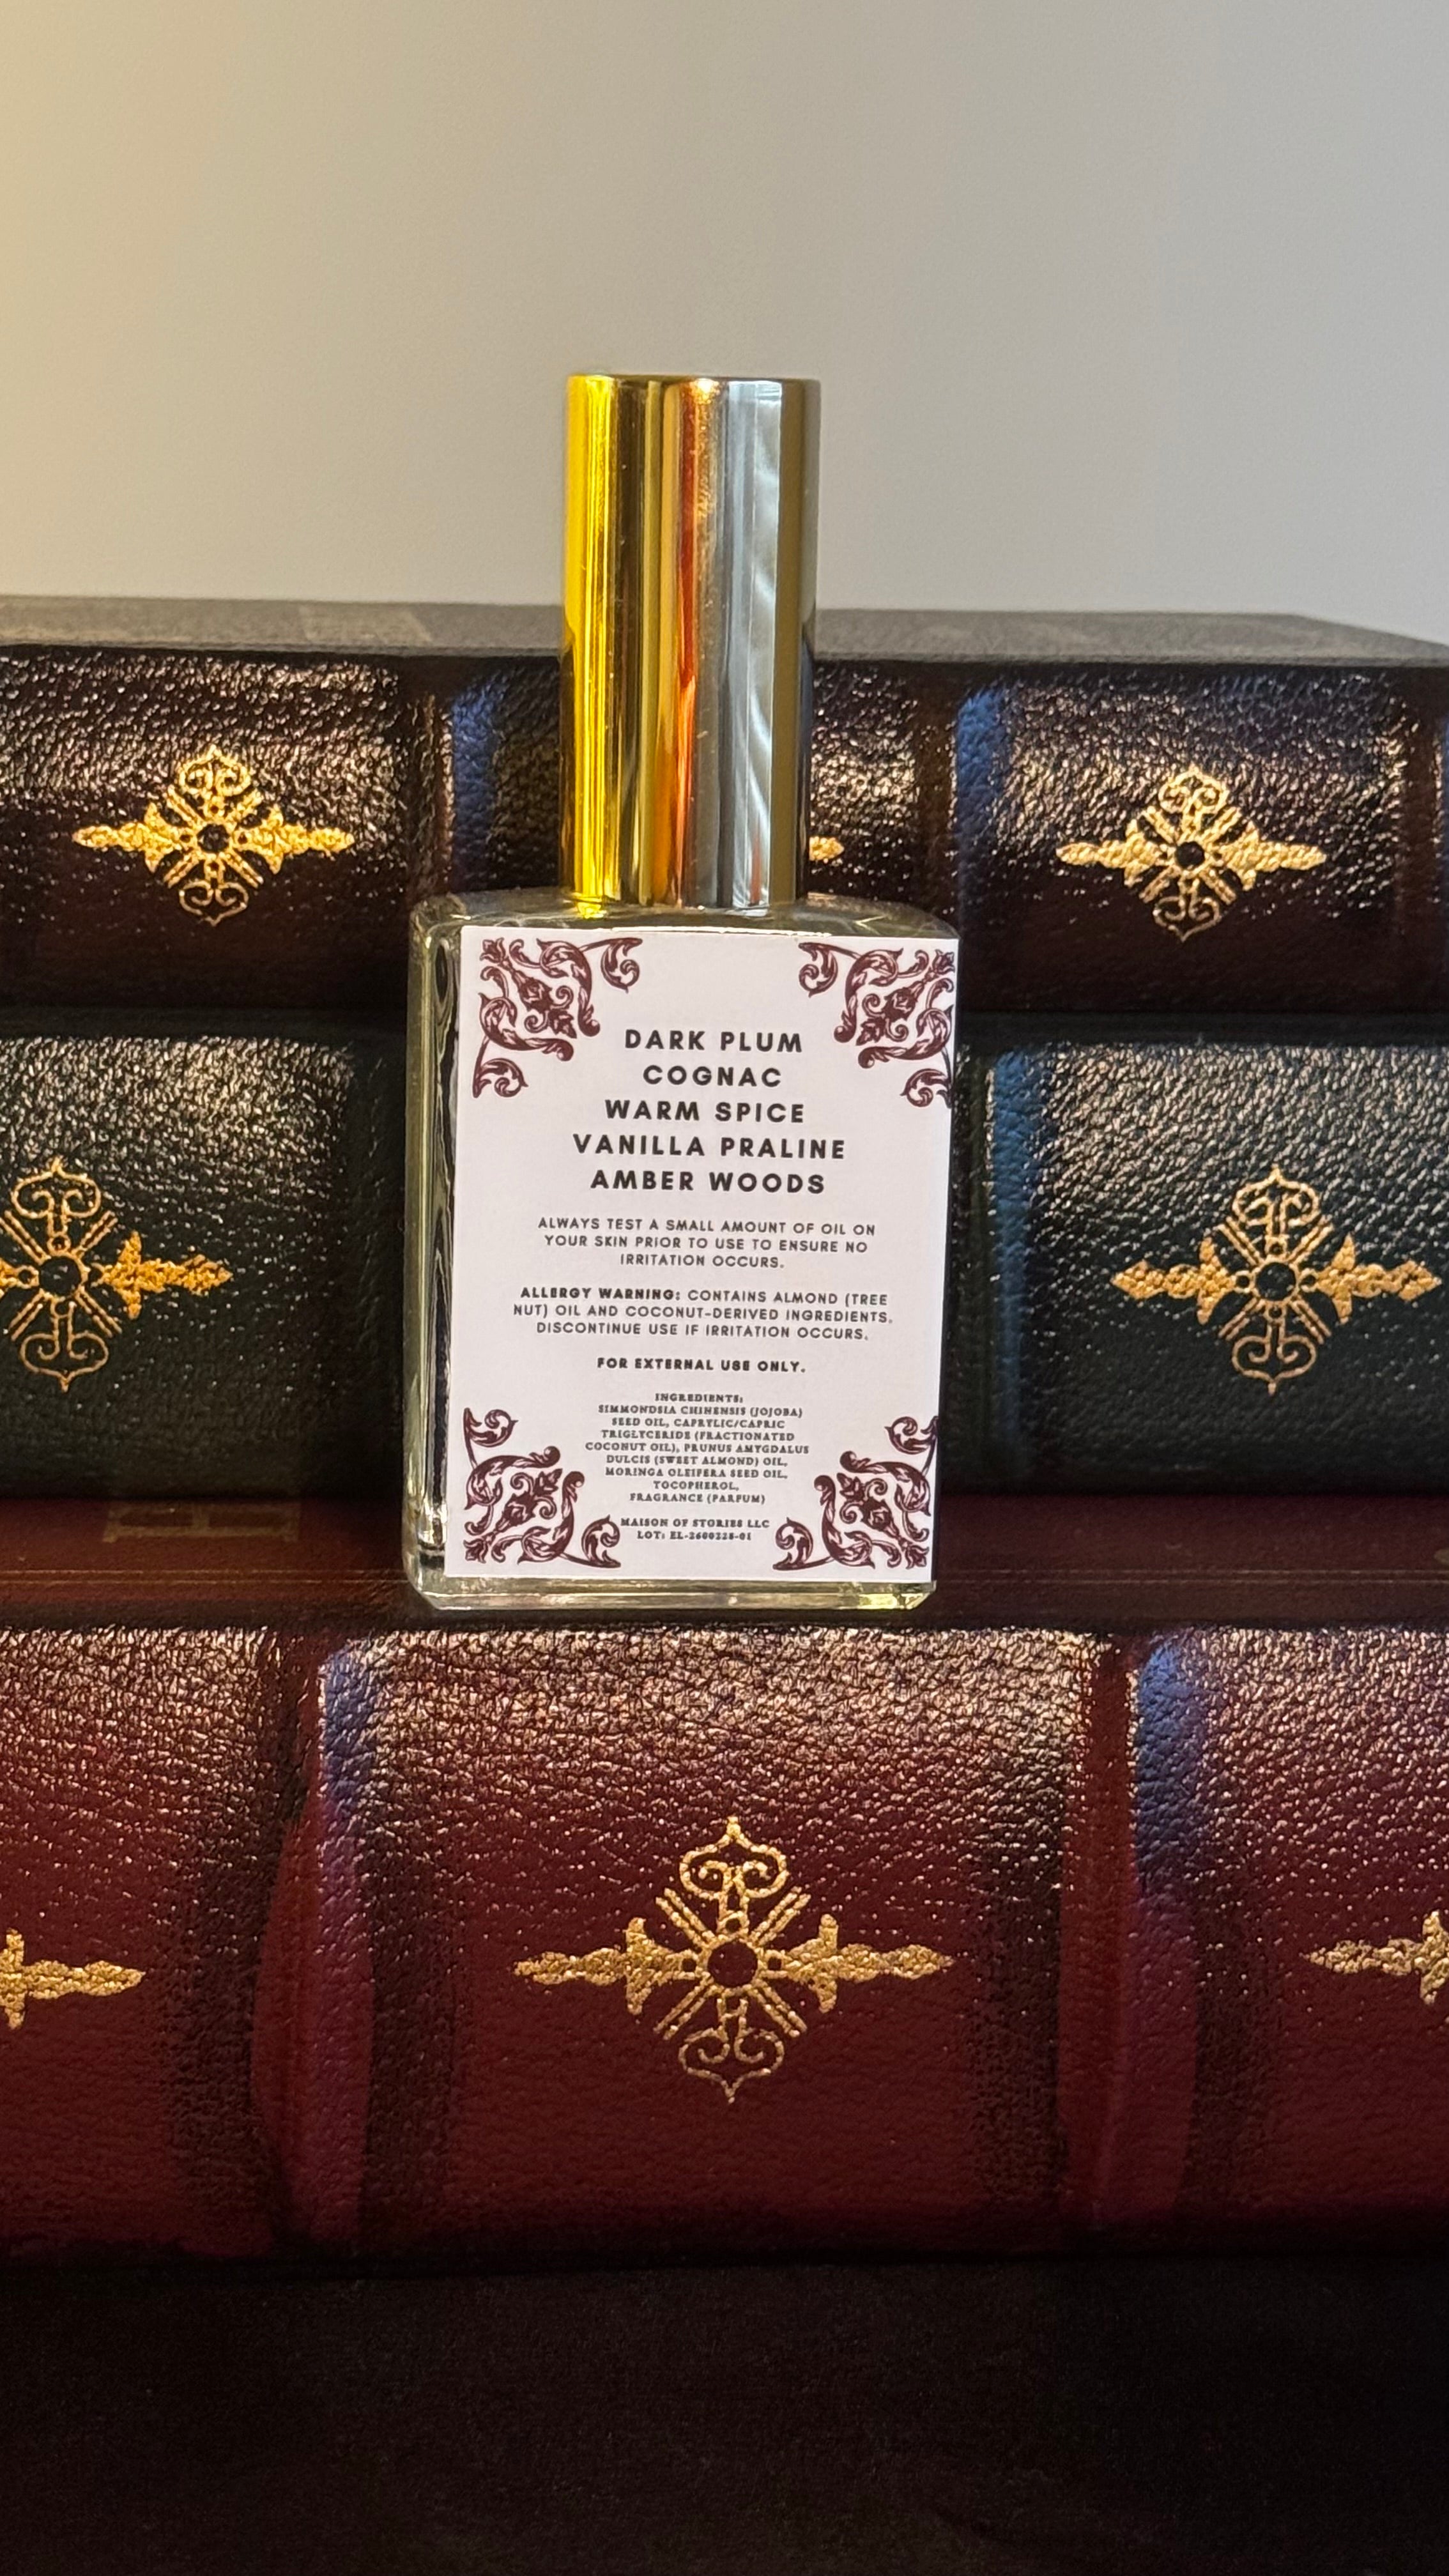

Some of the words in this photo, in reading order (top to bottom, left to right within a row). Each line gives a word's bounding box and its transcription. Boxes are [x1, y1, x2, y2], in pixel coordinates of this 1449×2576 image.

[625, 1029, 706, 1051] DARK
[720, 1031, 802, 1054] PLUM
[643, 1064, 781, 1088] COGNAC
[604, 1099, 700, 1121] WARM
[714, 1101, 804, 1123] SPICE
[572, 1133, 705, 1157] VANILLA
[720, 1137, 845, 1160] PRALINE
[590, 1169, 694, 1192] AMBER
[709, 1171, 825, 1195] WOODS
[537, 1216, 600, 1230] ALWAYS
[606, 1218, 643, 1230] TEST
[648, 1218, 659, 1230] A
[666, 1219, 714, 1232] SMALL
[720, 1220, 786, 1234] AMOUNT
[793, 1222, 815, 1234] OF
[821, 1223, 846, 1236] OIL
[852, 1224, 875, 1236] ON
[544, 1234, 588, 1247] YOUR
[594, 1235, 628, 1248] SKIN
[635, 1236, 681, 1248] PRIOR
[688, 1237, 708, 1249] TO
[715, 1238, 744, 1250] USE
[752, 1238, 772, 1251] TO
[779, 1239, 838, 1253] ENSURE
[845, 1241, 868, 1254] NO
[620, 1254, 705, 1266] IRRITATION
[712, 1255, 784, 1269] OCCURS.
[520, 1287, 592, 1299] ALLERGY
[598, 1287, 680, 1301] WARNING:
[687, 1289, 767, 1303] CONTAINS
[773, 1291, 838, 1305] ALMOND
[845, 1292, 887, 1308] (TREE
[513, 1303, 548, 1319] NUT)
[555, 1305, 581, 1317] OIL
[586, 1305, 618, 1317] AND
[625, 1305, 779, 1321] COCONUT-DERIVED
[786, 1309, 893, 1324] INGREDIENTS.
[536, 1321, 641, 1335] DISCONTINUE
[648, 1323, 678, 1335] USE
[685, 1324, 699, 1336] IF
[705, 1324, 790, 1338] IRRITATION
[797, 1326, 868, 1340] OCCURS.
[597, 1357, 628, 1369] FOR
[634, 1358, 714, 1371] EXTERNAL
[721, 1359, 750, 1372] USE
[757, 1360, 806, 1373] ONLY.
[655, 1393, 744, 1404] INGREDIENTS:
[598, 1404, 677, 1414] SIMMONDSIA
[680, 1406, 746, 1416] CHINENSIS
[749, 1407, 803, 1418] (JOJOBA)
[611, 1417, 641, 1427] SEED
[673, 1418, 785, 1429] CAPRYLIC/CAPRIC
[601, 1429, 691, 1440] TRIGLYCERIDE
[694, 1431, 795, 1442] (FRACTIONATED
[585, 1441, 647, 1452] COCONUT
[684, 1443, 732, 1453] PRUNUS
[735, 1445, 809, 1454] AMYGDALUS
[606, 1454, 650, 1464] DULCIS
[654, 1455, 698, 1466] (SWEET
[702, 1456, 759, 1467] ALMOND)
[605, 1466, 664, 1477] MORINGA
[668, 1468, 726, 1478] OLEIFERA
[730, 1469, 759, 1478] SEED
[629, 1492, 703, 1503] FRAGRANCE
[707, 1494, 765, 1505] (PARFUM)
[620, 1517, 669, 1527] MAISON
[672, 1518, 689, 1528] OF
[692, 1519, 743, 1528] STORIES
[747, 1519, 770, 1529] LLC
[637, 1530, 665, 1540] LOT:
